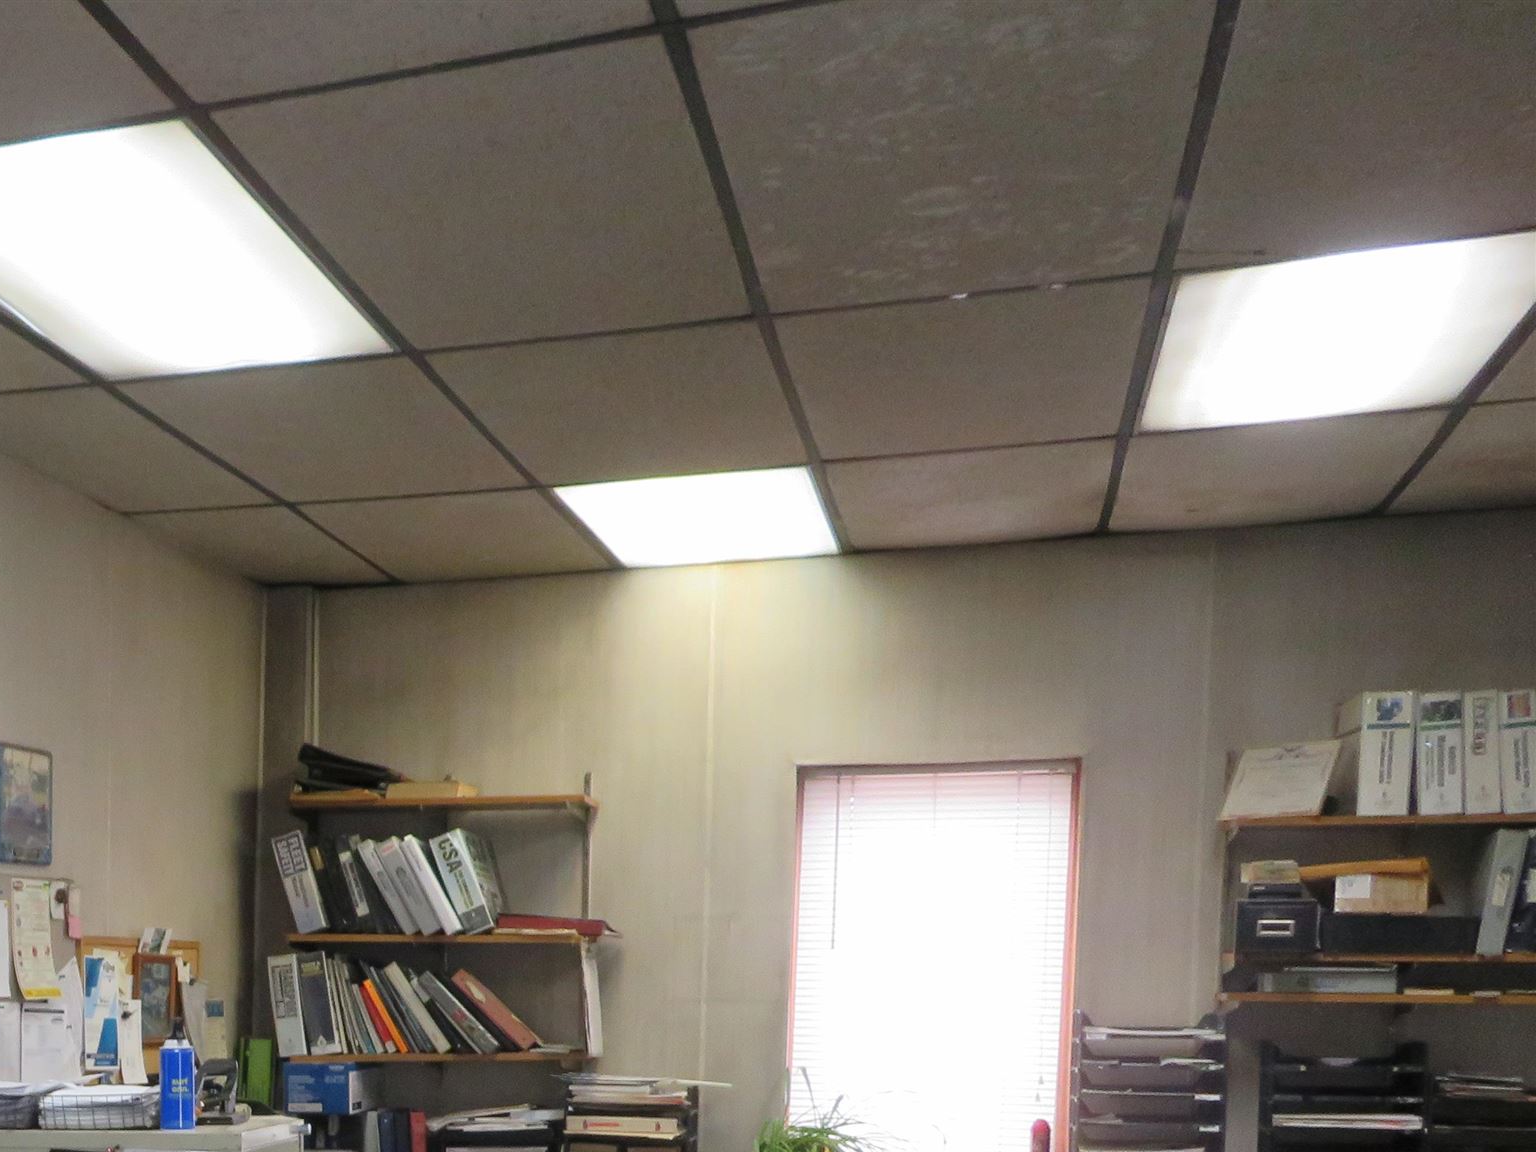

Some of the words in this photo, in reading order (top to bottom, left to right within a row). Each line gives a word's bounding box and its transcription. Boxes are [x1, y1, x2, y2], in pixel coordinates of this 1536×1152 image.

[276, 839, 294, 876] SAFETY
[289, 836, 306, 872] FLEET
[438, 838, 462, 873] CSA
